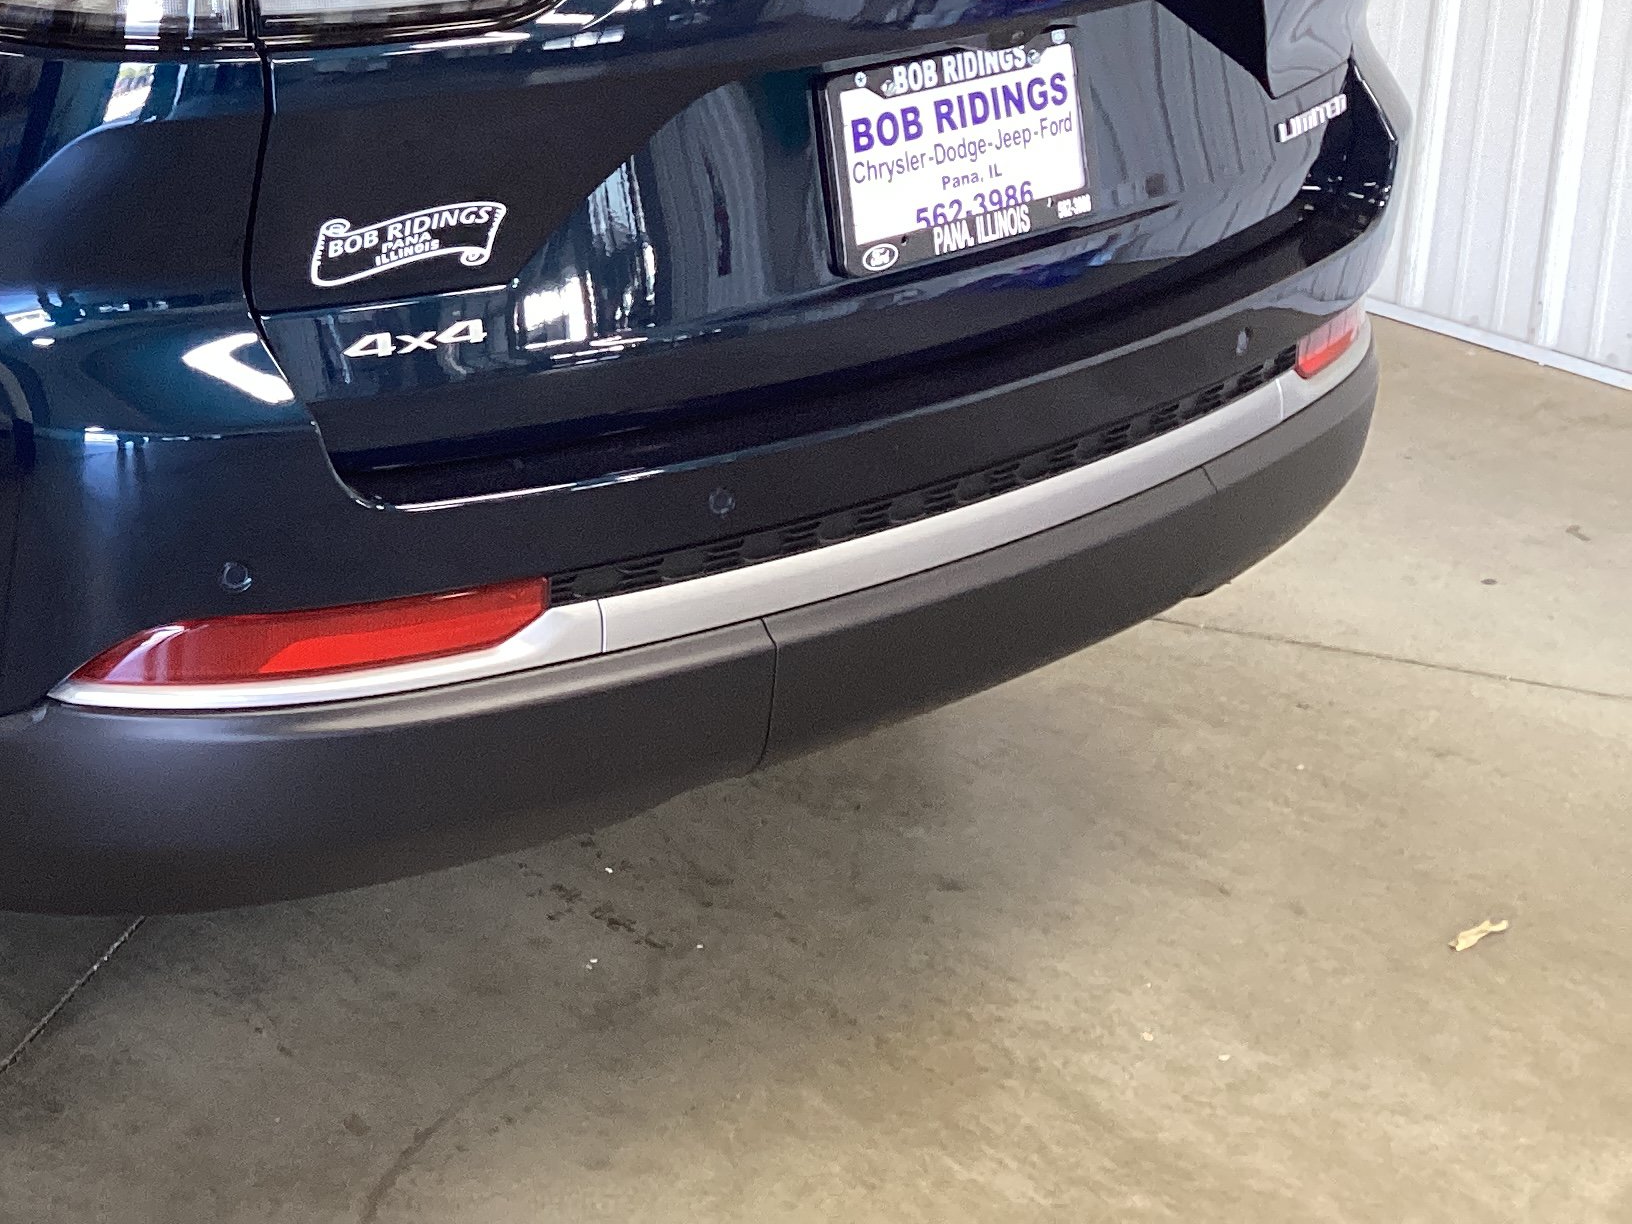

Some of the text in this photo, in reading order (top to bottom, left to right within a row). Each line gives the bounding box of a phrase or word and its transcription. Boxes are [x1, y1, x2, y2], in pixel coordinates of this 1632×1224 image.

[891, 44, 1027, 95] BOB RIDINGS
[850, 72, 1069, 154] BOB RIDINGS
[852, 111, 1073, 185] Chrysler-Dodge-Jeep-Ford
[988, 163, 1003, 179] IL
[327, 206, 493, 259] BOB RIDINGS
[381, 231, 432, 254] PANA
[976, 204, 1032, 245] ILLINOIS
[374, 239, 441, 267] ILLINOIS
[343, 319, 488, 358] 4x4
